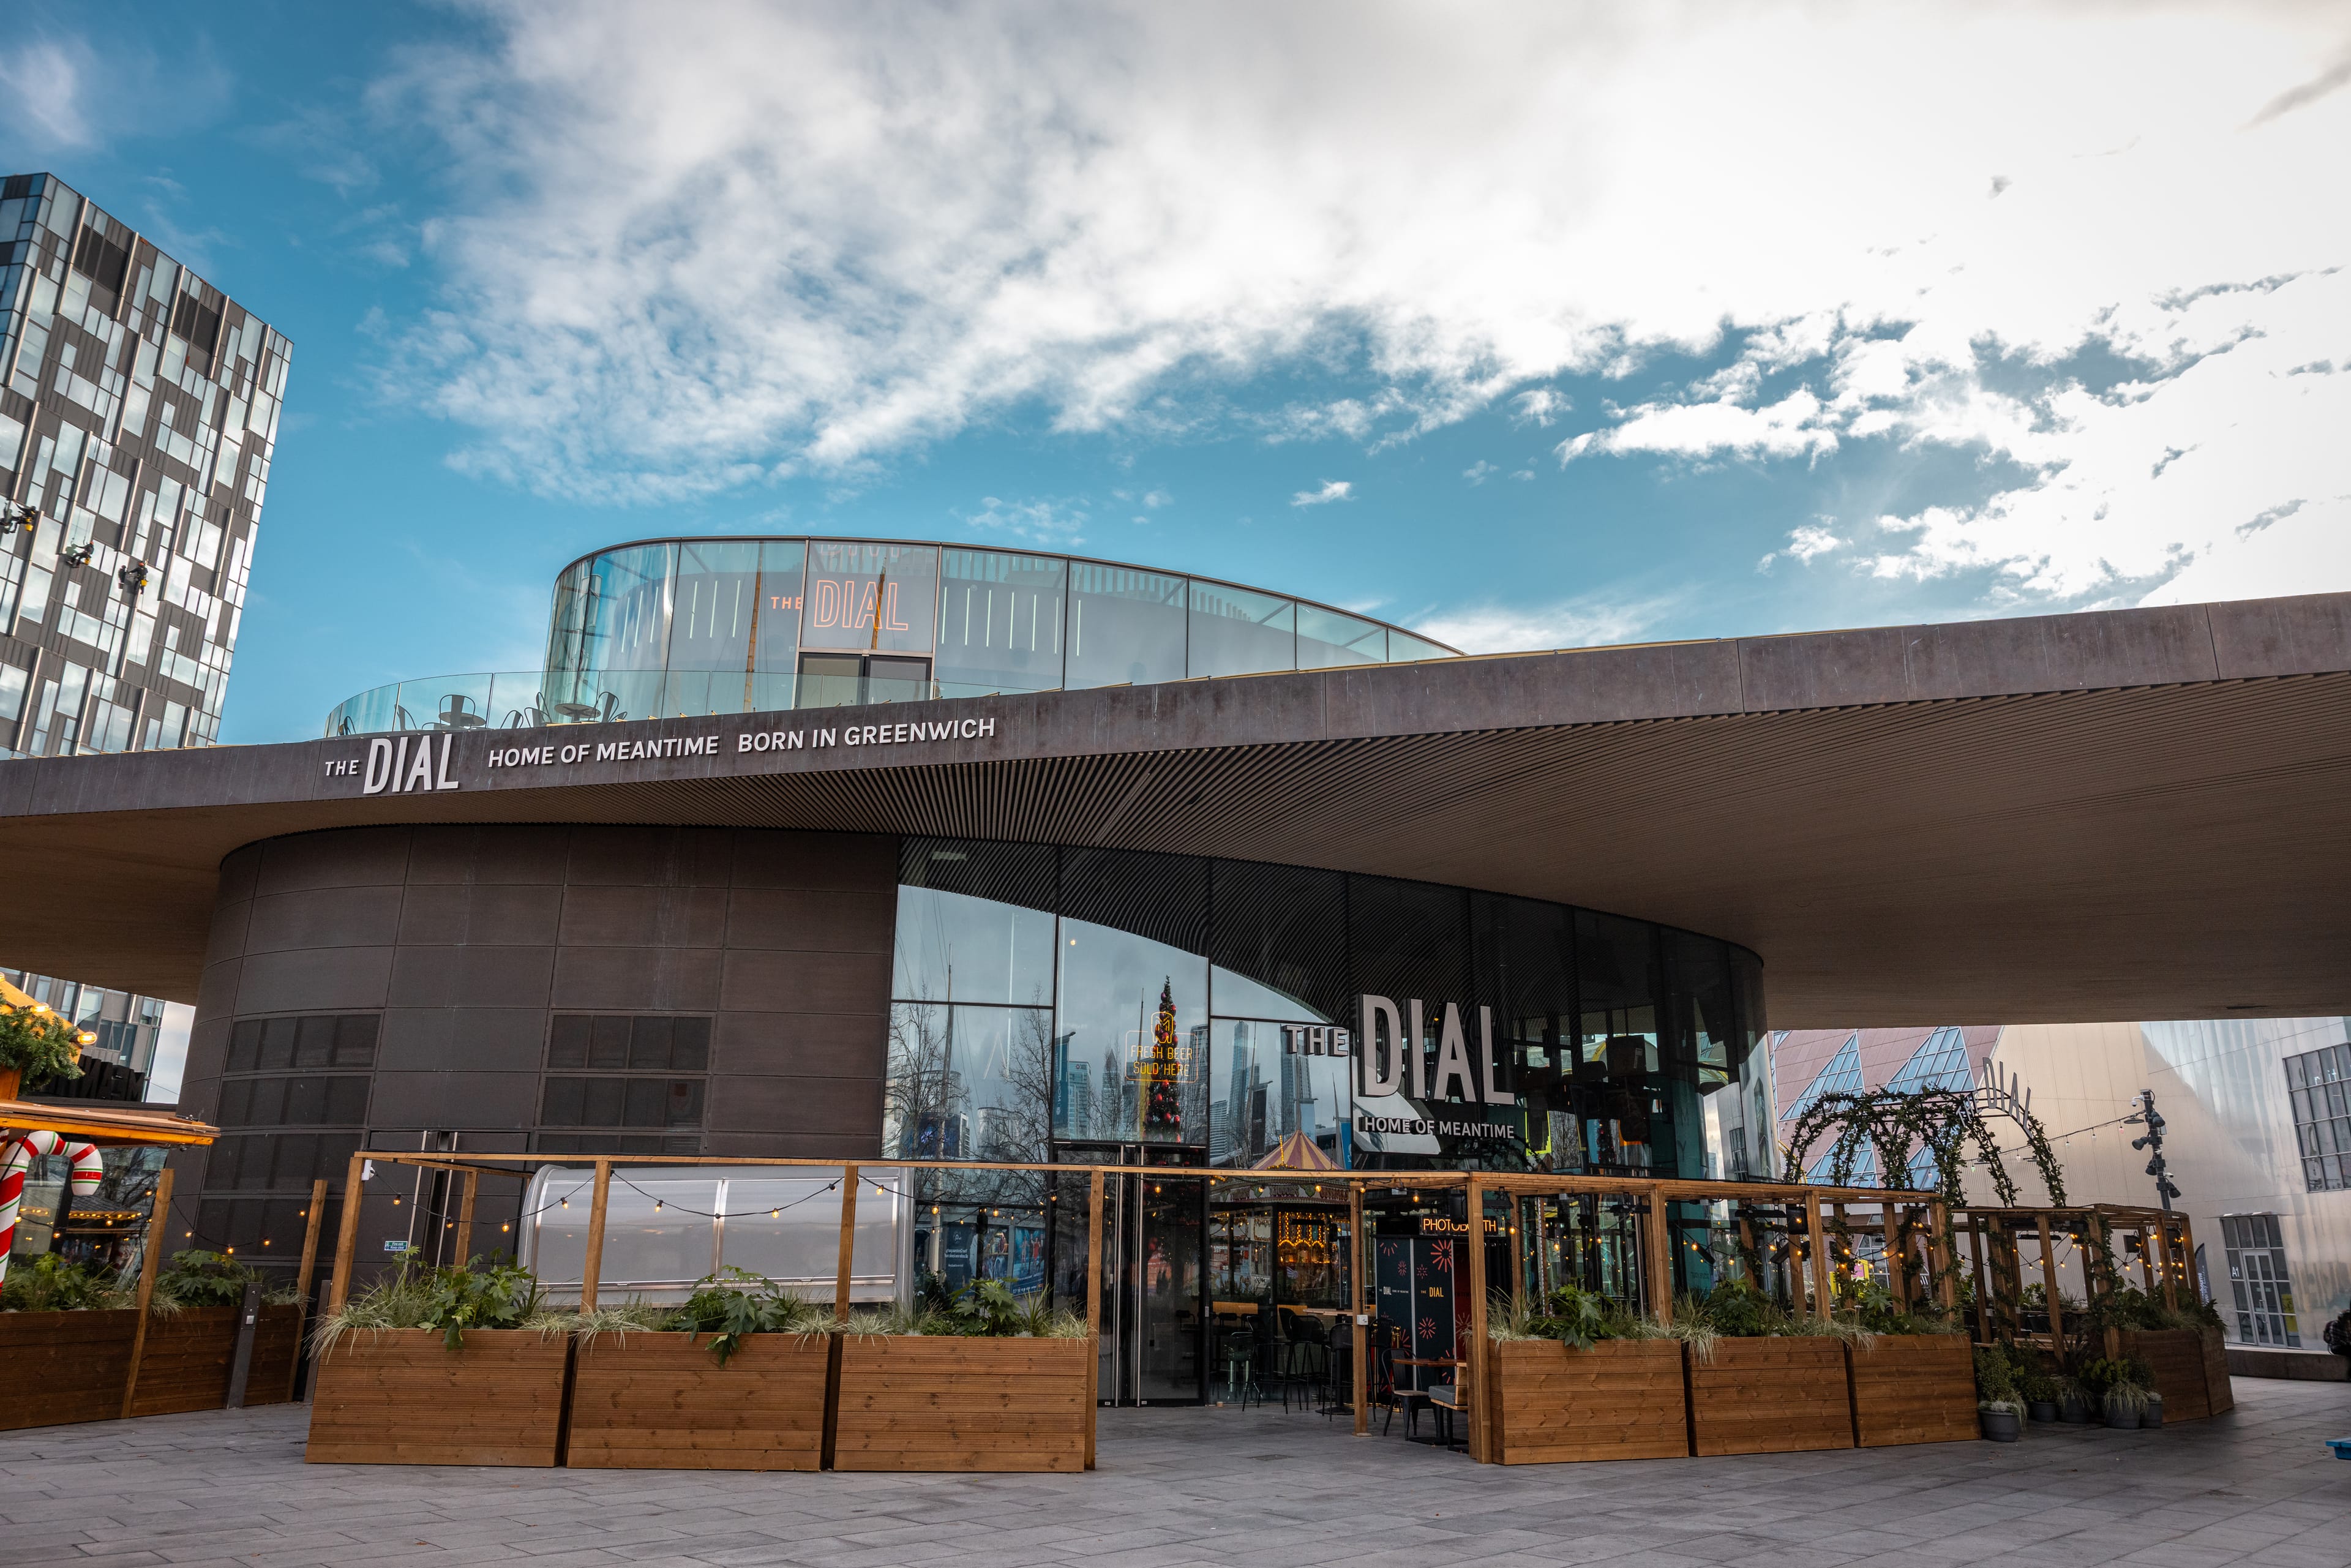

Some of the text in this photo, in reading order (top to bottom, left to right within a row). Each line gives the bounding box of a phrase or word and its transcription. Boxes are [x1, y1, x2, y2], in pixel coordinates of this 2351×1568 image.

[770, 580, 909, 631] THE DIAL
[325, 717, 996, 794] THE DIAL HOME OF MEANTIME BORN IN GREENWICH
[1131, 1045, 1193, 1060] FRESH BEER
[1284, 993, 1515, 1105] THE DIAL
[1133, 1061, 1190, 1077] SOLD HERE
[1982, 1057, 2034, 1139] DIAL
[1364, 1116, 1515, 1139] HOME OF MEANTIME
[2232, 1266, 2240, 1277] A1
[1383, 1286, 1392, 1295] DIAL
[1429, 1286, 1444, 1297] DIAL
